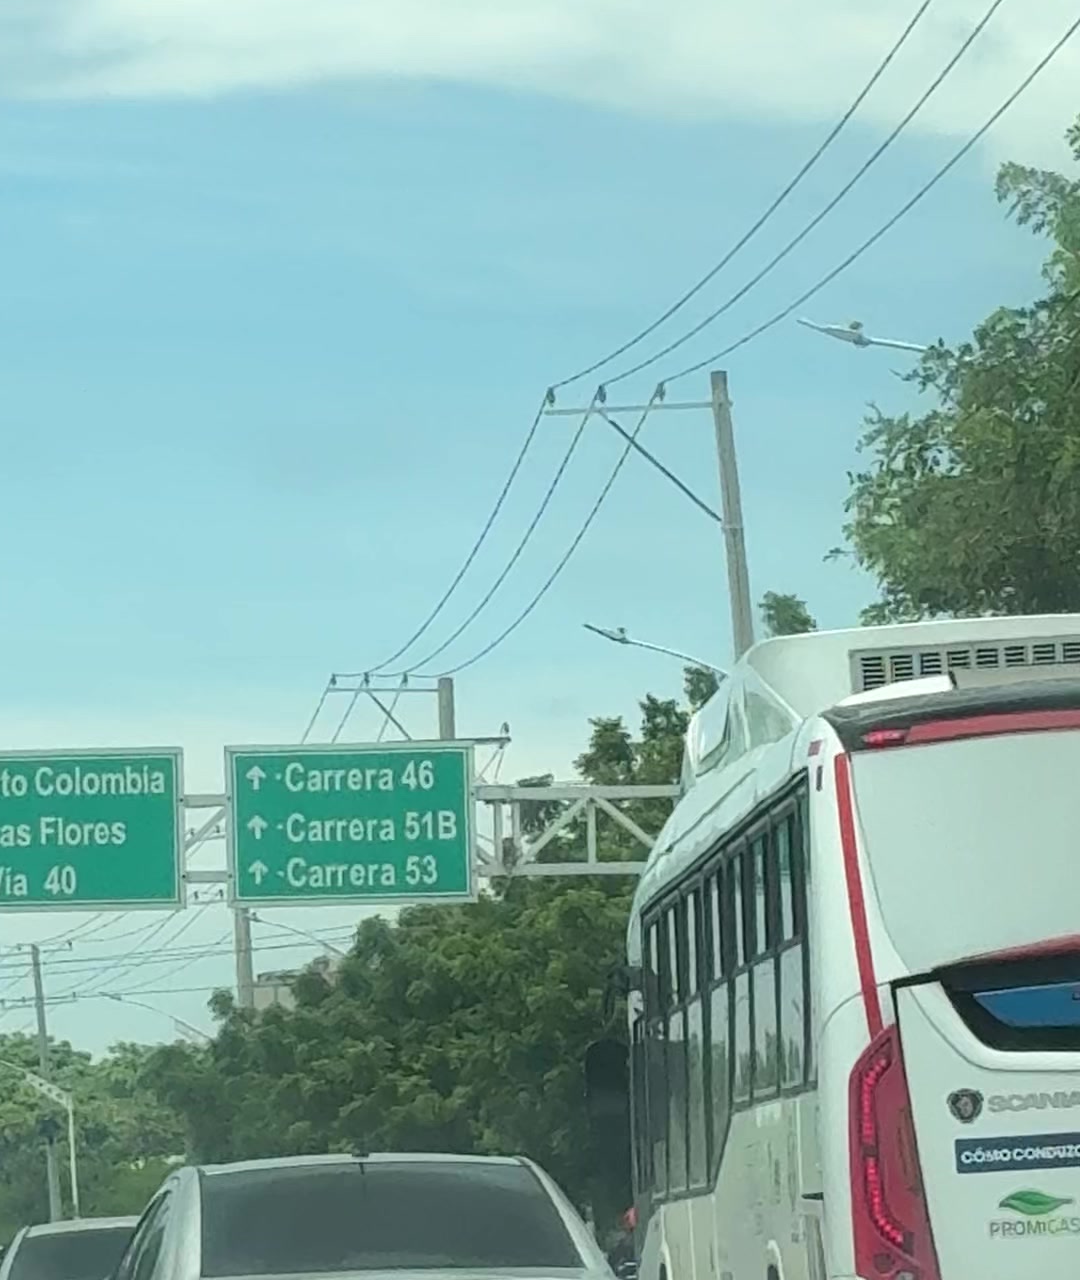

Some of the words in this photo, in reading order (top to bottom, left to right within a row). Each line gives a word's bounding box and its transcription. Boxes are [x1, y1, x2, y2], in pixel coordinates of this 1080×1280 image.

[35, 765, 166, 795] Colombia
[285, 762, 394, 793] Carrera
[400, 760, 435, 791] 46
[41, 817, 127, 846] Flores
[286, 812, 396, 842] Carrera
[404, 810, 457, 840] 51B
[44, 865, 77, 895] 40
[287, 857, 397, 888] Carrera
[405, 855, 438, 885] 53
